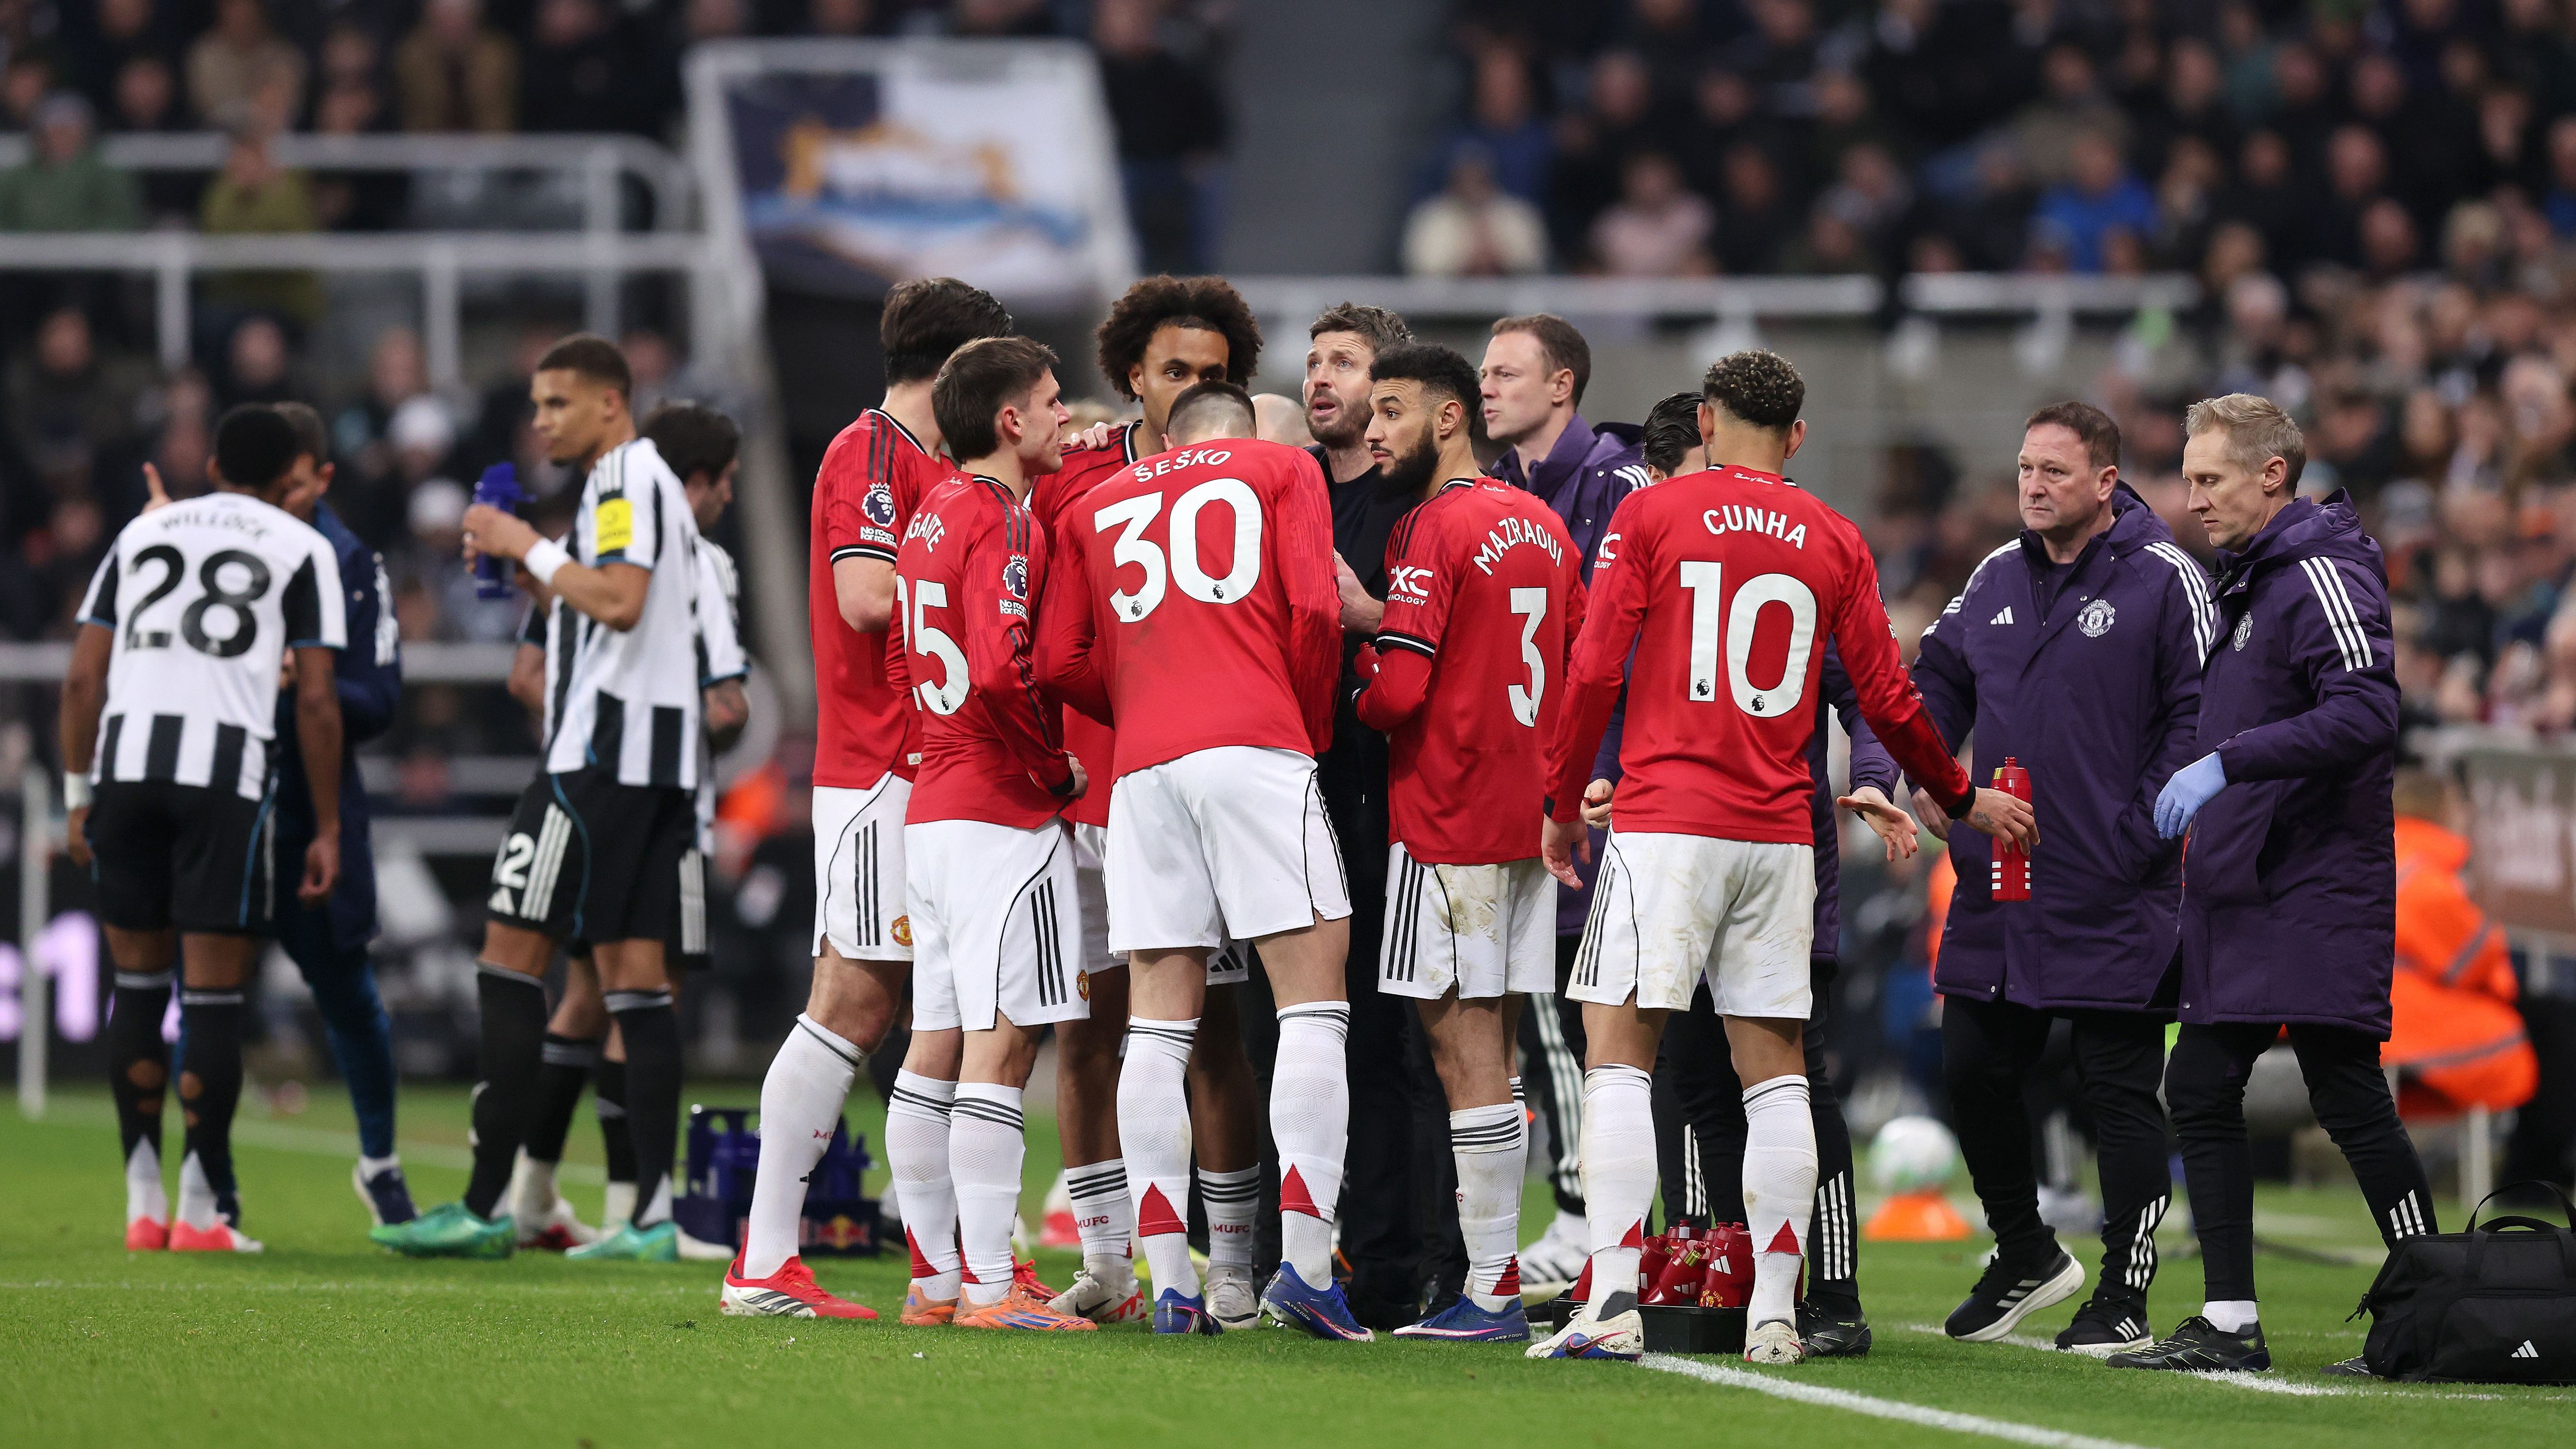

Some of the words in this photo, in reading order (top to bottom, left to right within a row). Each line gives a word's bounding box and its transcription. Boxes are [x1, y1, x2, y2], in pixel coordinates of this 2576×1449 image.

[1134, 449, 1232, 483] ŠEŠKO
[160, 511, 271, 542] WILLOCK
[860, 526, 874, 534] No
[1703, 504, 1806, 549] CUNHA
[1094, 477, 1263, 623] 30
[1473, 517, 1562, 576] MAZRAOUI
[1594, 561, 1611, 569] OLOGY
[125, 544, 272, 658] 28
[999, 599, 1012, 608] No
[1387, 594, 1427, 606] HNOLOGY
[1680, 561, 1817, 718] 10
[2083, 627, 2104, 635] UNITED
[1508, 587, 1547, 727] 3
[1213, 1223, 1250, 1233] MUFC
